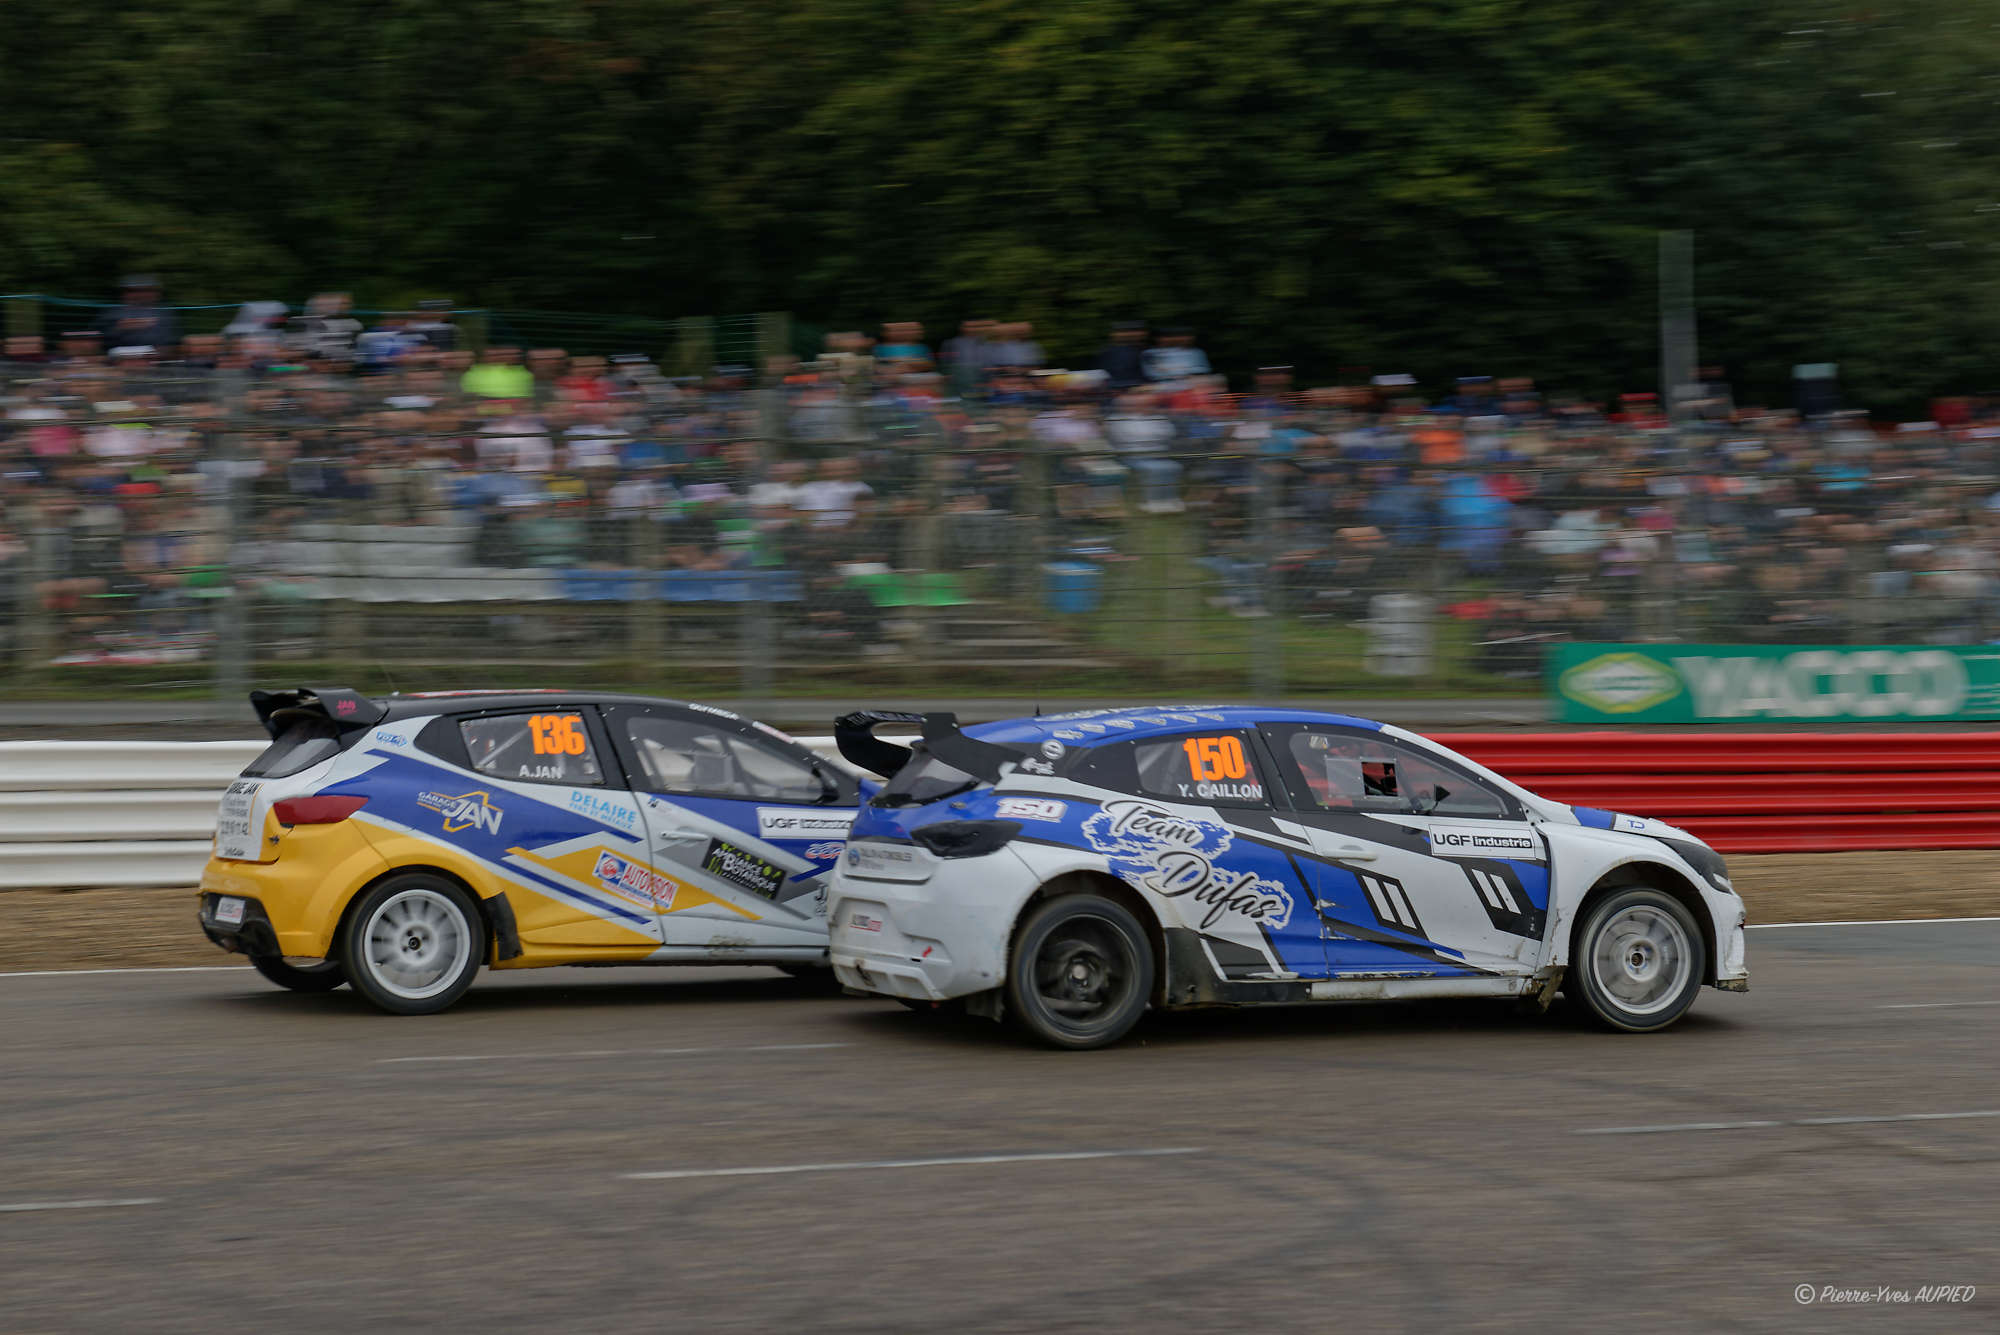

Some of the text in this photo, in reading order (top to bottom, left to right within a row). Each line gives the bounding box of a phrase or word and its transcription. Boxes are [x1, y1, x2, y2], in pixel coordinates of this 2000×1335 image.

[527, 715, 586, 755] 136
[519, 765, 562, 779] A.JAN
[1183, 736, 1247, 781] 150
[1177, 783, 1194, 797] Y.
[441, 799, 504, 835] JAN
[571, 791, 637, 823] DELAIRE
[762, 817, 799, 829] UGF
[995, 798, 1067, 821] 150
[1104, 800, 1200, 844] Team
[1433, 834, 1532, 848] UGF industrie
[1145, 851, 1283, 929] Dufas
